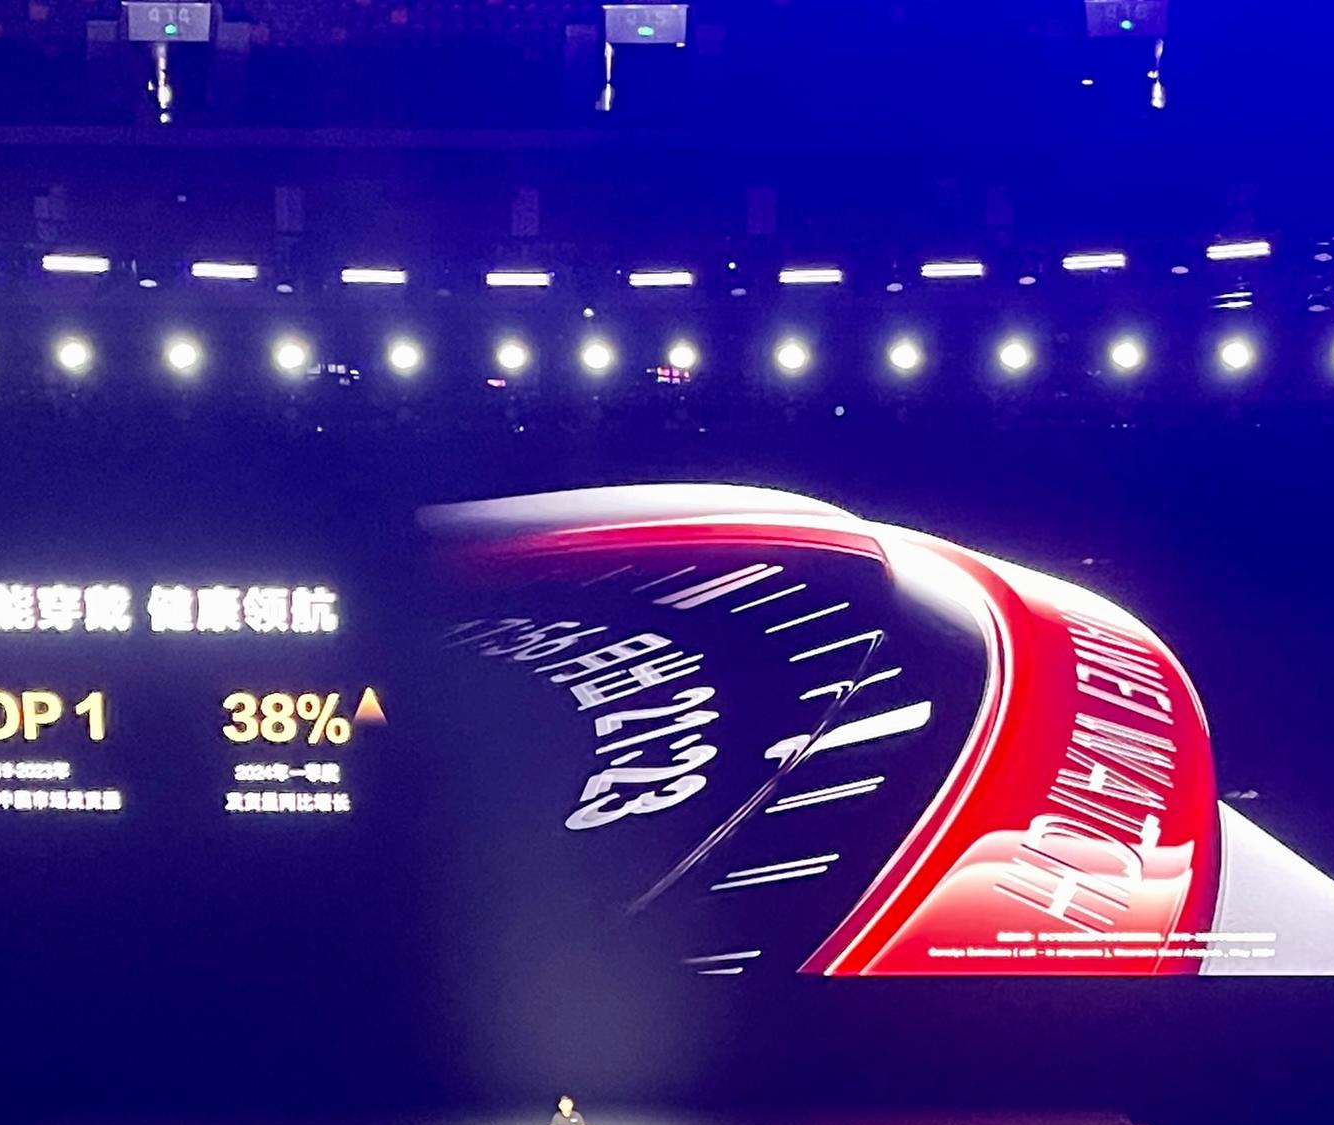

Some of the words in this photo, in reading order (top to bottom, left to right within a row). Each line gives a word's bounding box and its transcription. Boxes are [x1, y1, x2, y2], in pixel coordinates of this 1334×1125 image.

[147, 583, 339, 633] 健康领航
[75, 691, 105, 742] 1
[222, 691, 352, 745] 38%
[563, 686, 720, 831] 21:23
